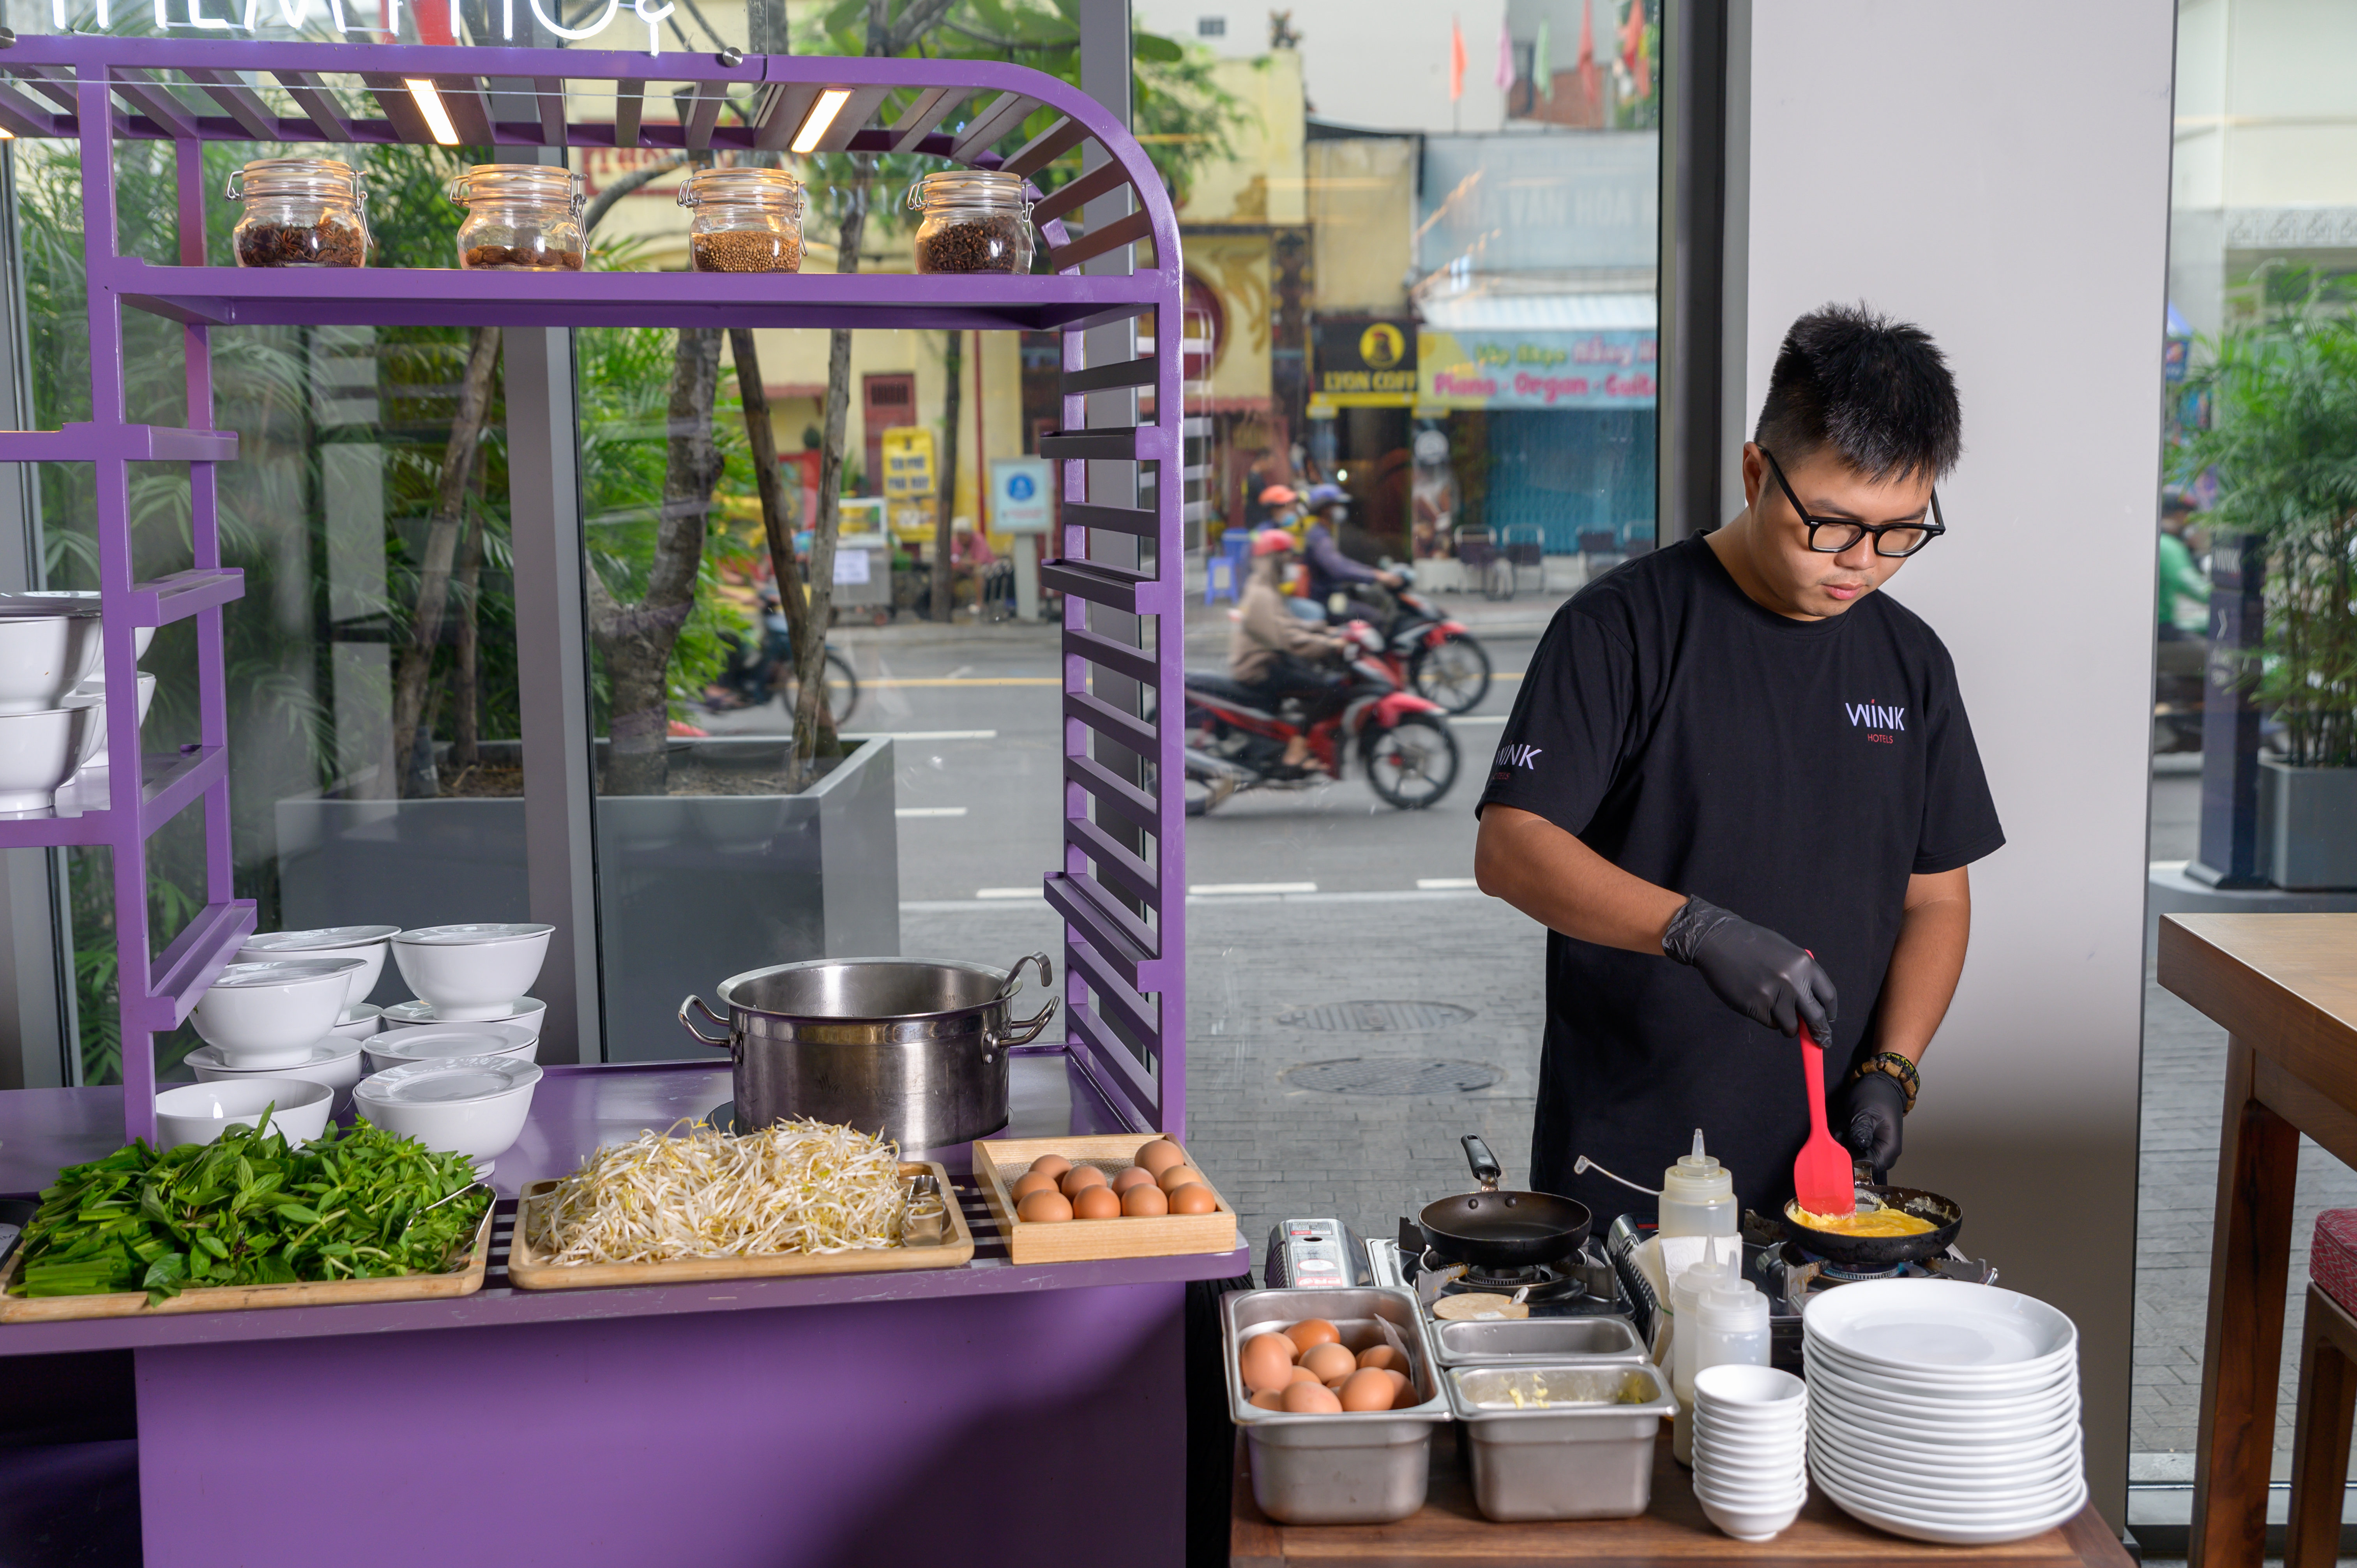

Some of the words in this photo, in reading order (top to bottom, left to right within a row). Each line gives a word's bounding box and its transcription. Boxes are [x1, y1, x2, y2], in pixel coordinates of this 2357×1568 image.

[1324, 371, 1370, 390] LYON
[1434, 373, 1497, 396] Piano
[1514, 372, 1588, 404] Organ
[1867, 733, 1894, 744] HOTELS
